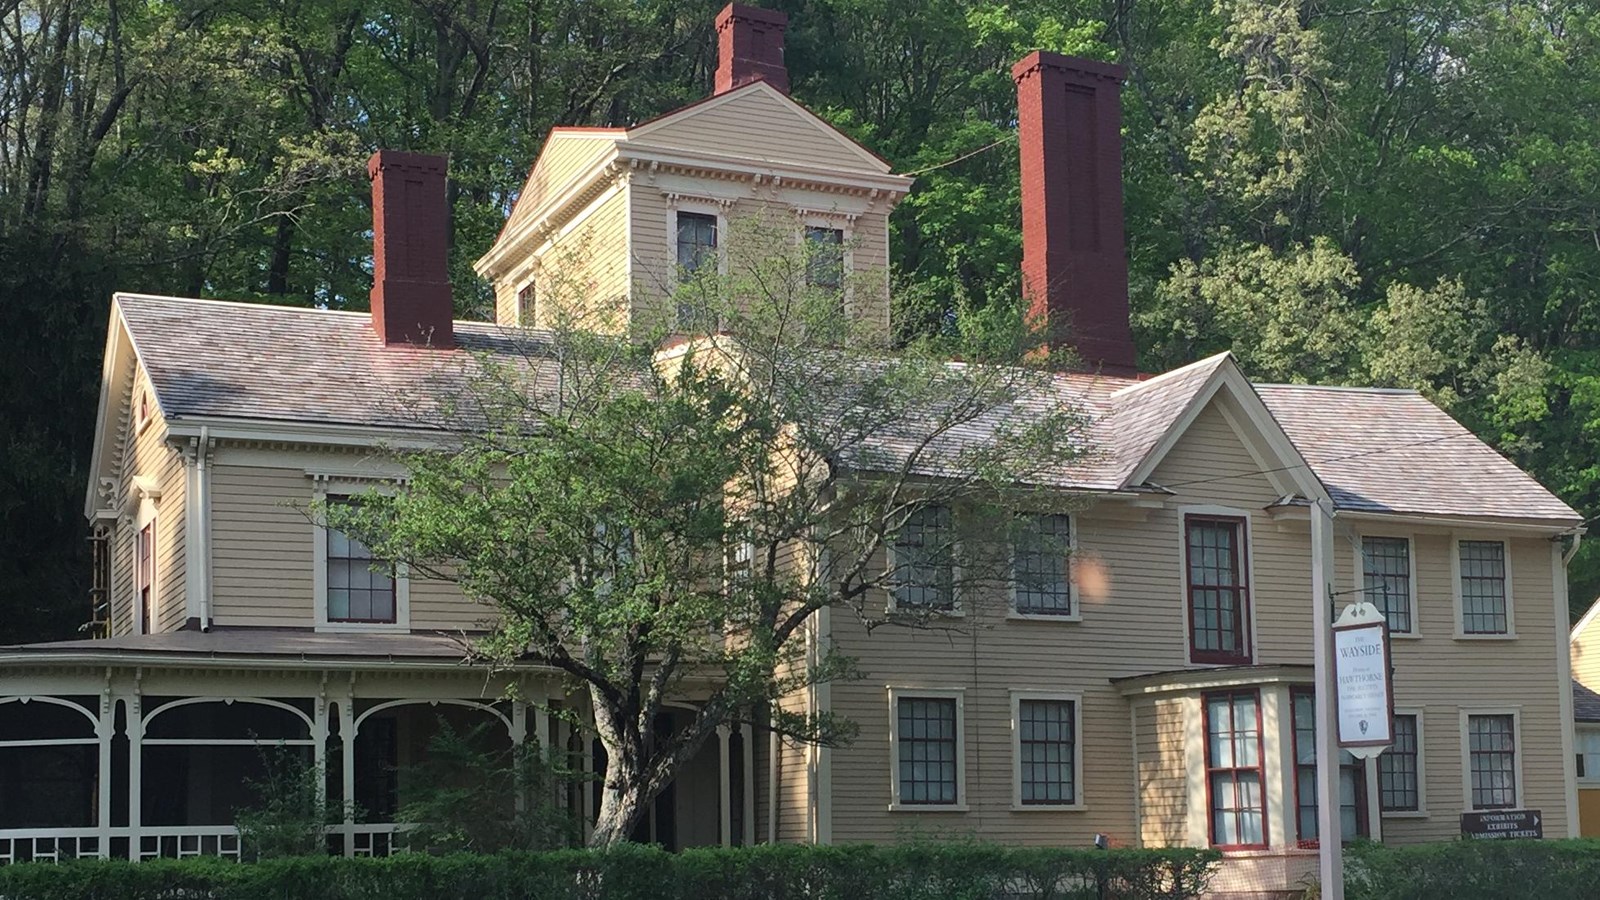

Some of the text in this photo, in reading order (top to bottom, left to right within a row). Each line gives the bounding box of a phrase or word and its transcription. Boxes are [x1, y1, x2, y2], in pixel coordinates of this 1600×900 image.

[1340, 644, 1381, 658] WAYSIDE
[1339, 673, 1383, 684] HAWTHORNE
[1480, 814, 1526, 822] INFORMATION
